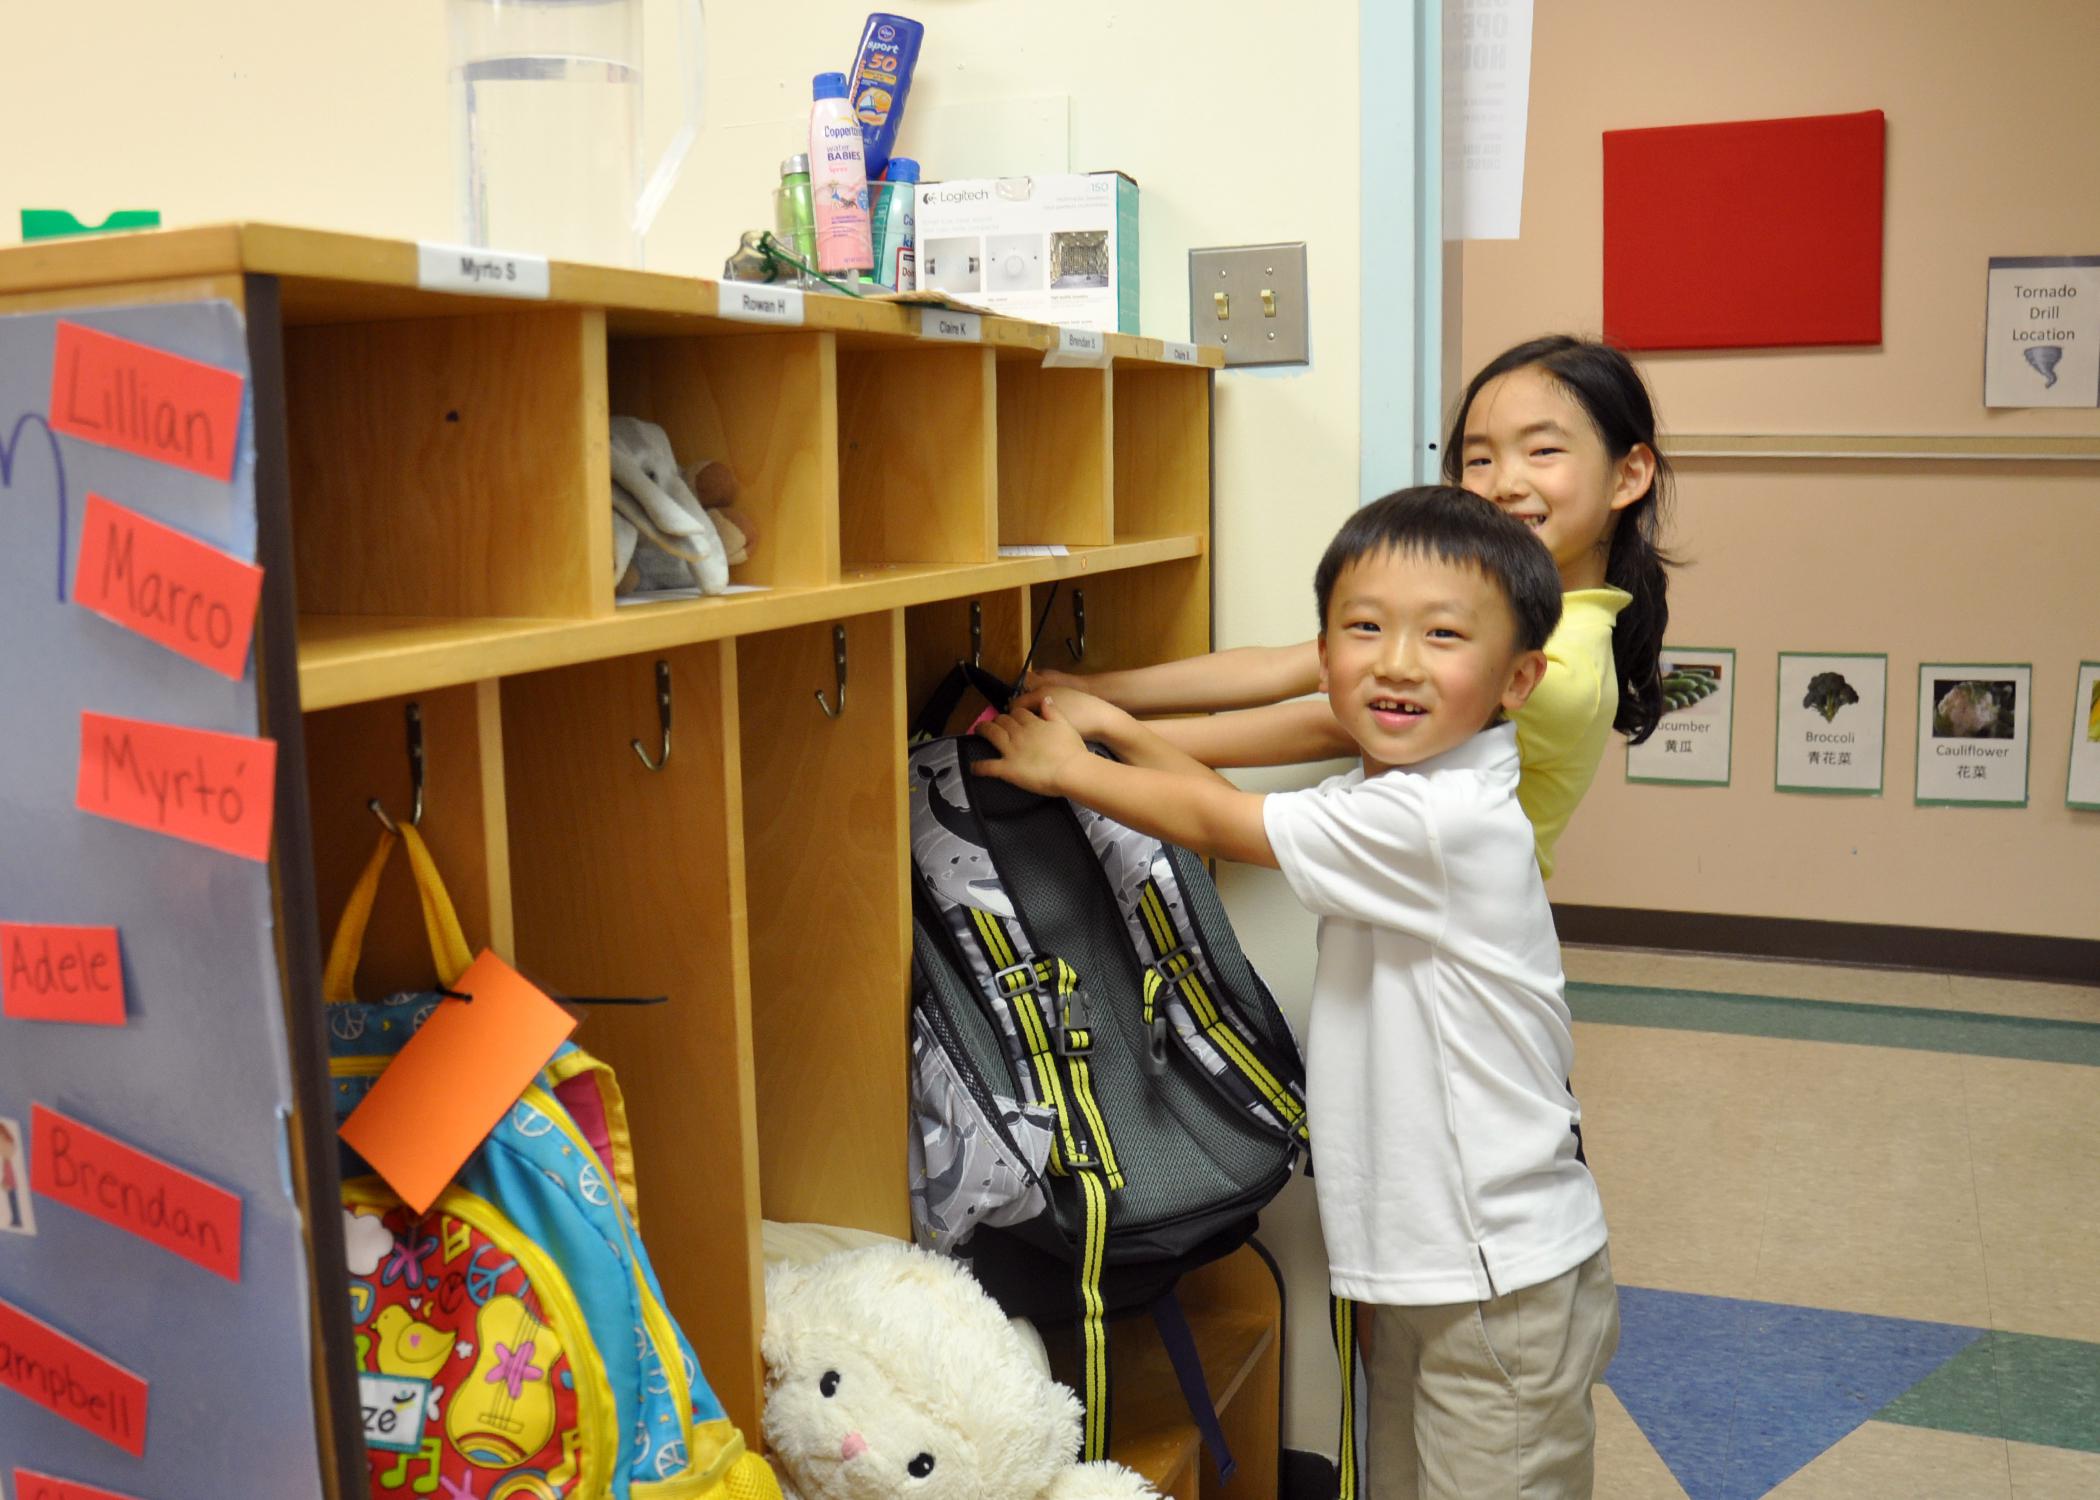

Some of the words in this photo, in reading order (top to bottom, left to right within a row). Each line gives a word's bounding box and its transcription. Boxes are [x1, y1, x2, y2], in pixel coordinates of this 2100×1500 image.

[867, 40, 899, 54] sport
[868, 52, 897, 72] 50
[827, 144, 849, 153] water
[827, 151, 861, 161] BABIES
[1090, 182, 1108, 193] 150
[940, 189, 988, 205] Logitech
[461, 256, 501, 283] Myrto
[504, 261, 517, 281] S
[2014, 284, 2077, 298] Tornado
[742, 294, 774, 312] Rowan
[778, 299, 785, 314] H
[2030, 305, 2059, 320] Drill
[939, 320, 958, 335] Claire
[959, 322, 966, 336] K
[2012, 327, 2075, 341] Location
[68, 346, 215, 462] Lillian
[103, 522, 232, 649] Marco
[1657, 719, 1711, 733] ucumber
[1805, 731, 1855, 744] Broccoli
[1665, 739, 1692, 753] 黄瓜
[1936, 744, 2009, 758] Cauliflower
[1808, 751, 1852, 766] 青花菜
[103, 733, 247, 826] Myrtó
[1957, 765, 1987, 780] 花菜
[10, 935, 112, 995] Adele
[51, 1124, 223, 1255] Brendan
[0, 1341, 131, 1438] ampbell
